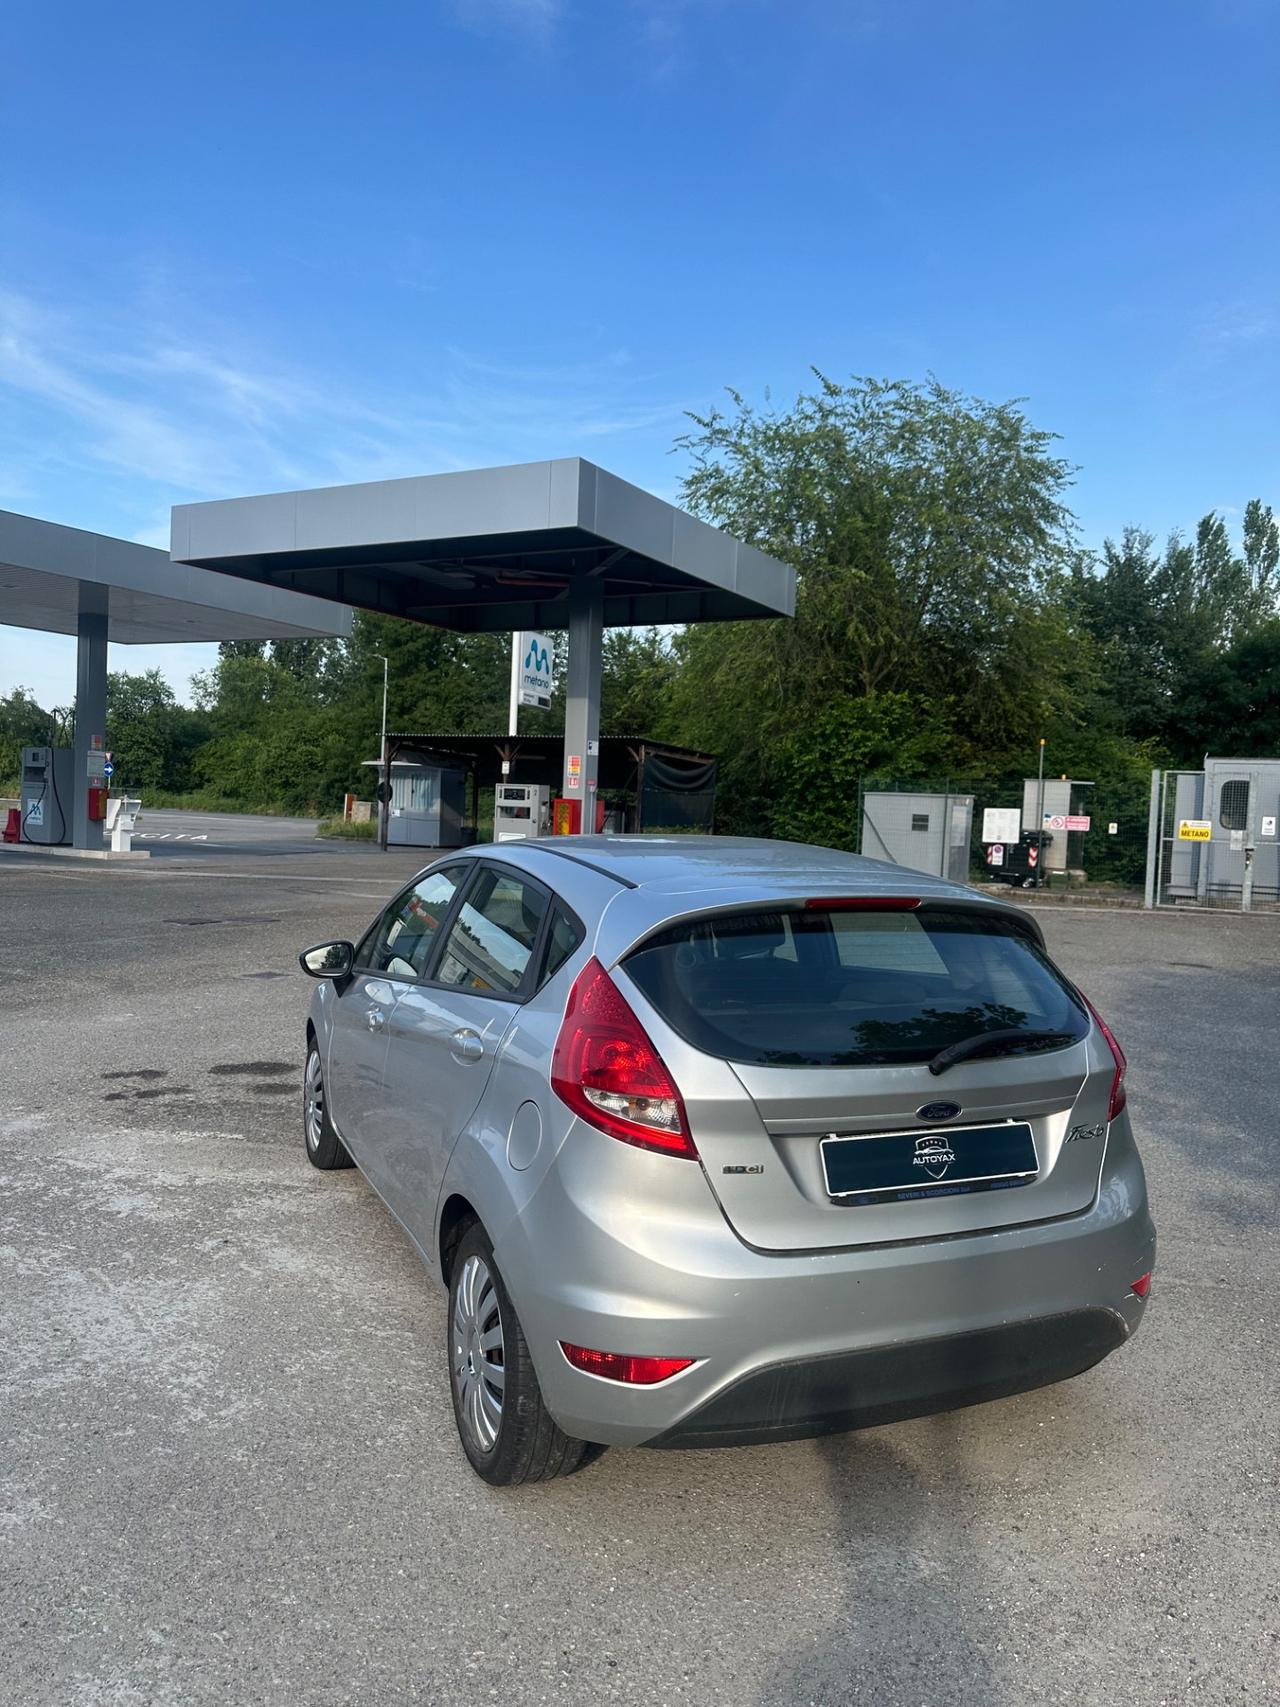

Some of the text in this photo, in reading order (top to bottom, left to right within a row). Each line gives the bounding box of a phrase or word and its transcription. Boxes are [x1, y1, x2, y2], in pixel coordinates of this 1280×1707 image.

[524, 674, 550, 688] metano
[1181, 829, 1209, 838] METANO
[1064, 1121, 1105, 1144] Fiesta
[912, 1152, 956, 1165] AUTOYAX
